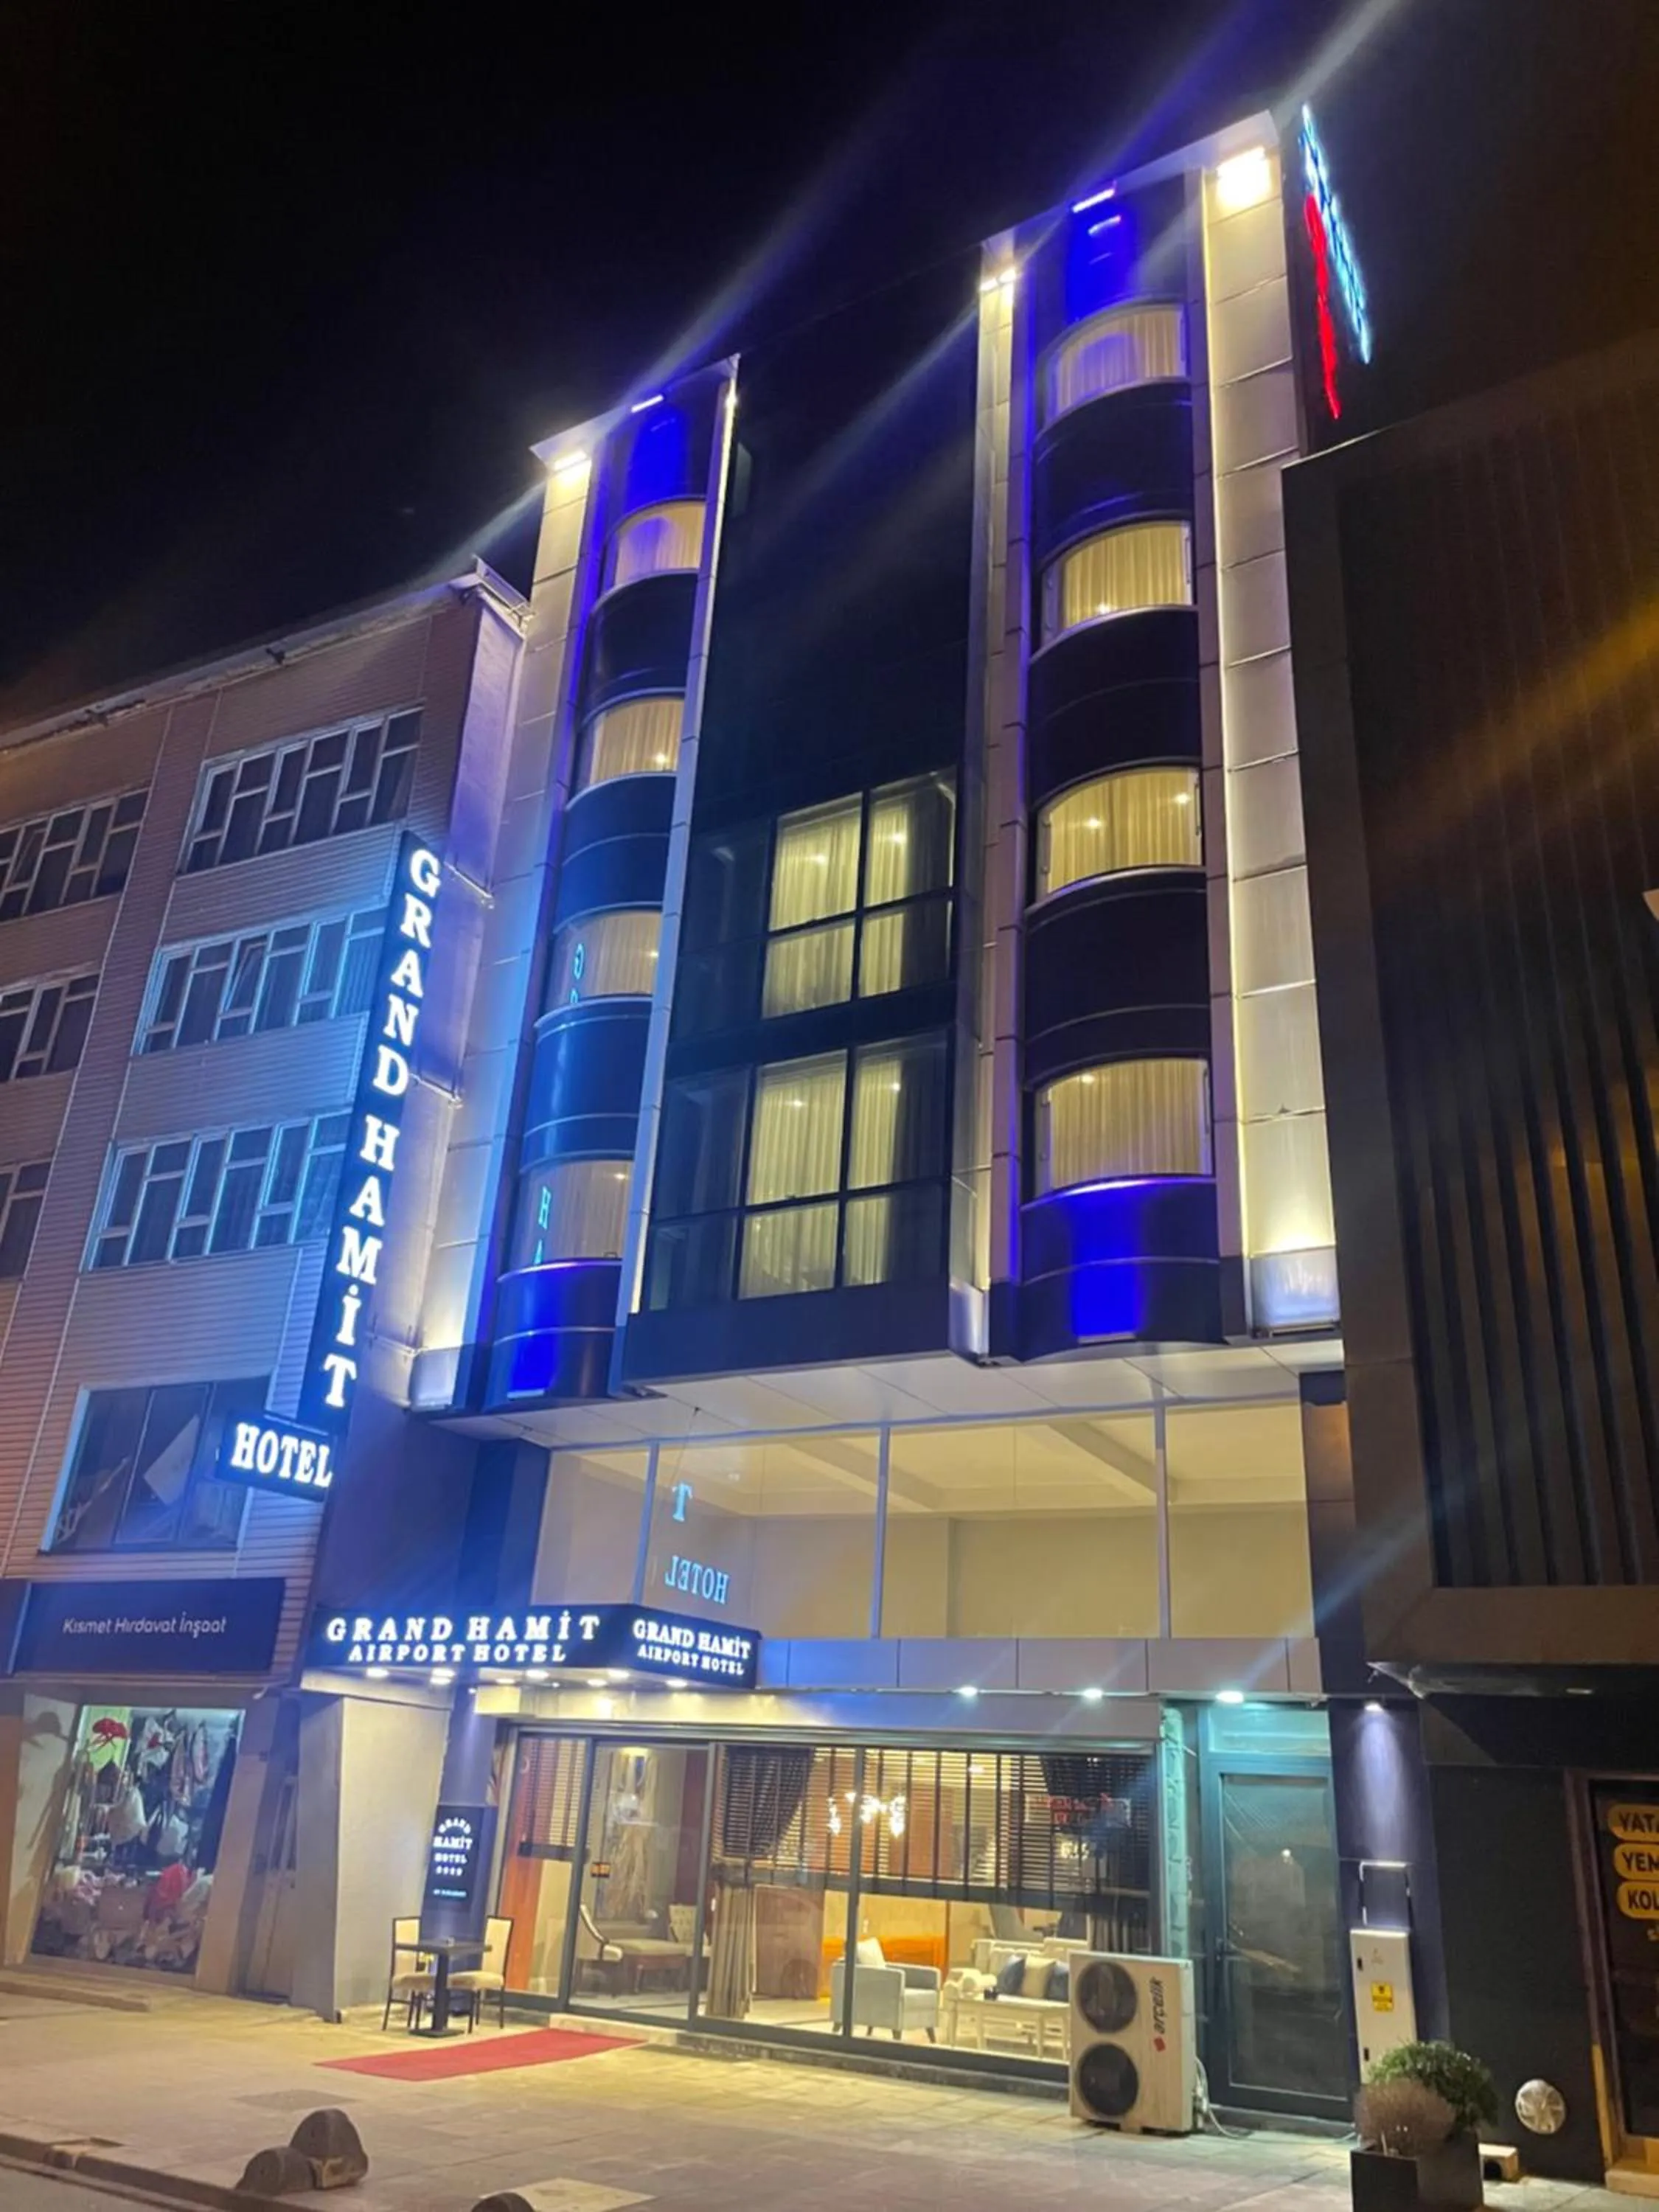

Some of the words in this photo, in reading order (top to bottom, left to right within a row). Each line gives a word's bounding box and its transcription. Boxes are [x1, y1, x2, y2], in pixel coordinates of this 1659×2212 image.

[372, 848, 441, 1097] GRAND
[323, 1114, 400, 1408] HAMİT
[230, 1422, 333, 1488] HOTEL
[326, 1616, 453, 1642] GRAND
[466, 1610, 600, 1641] HAMİT
[633, 1618, 695, 1649] GRAND
[698, 1632, 751, 1660] HAMİT
[348, 1644, 466, 1663] AIRPORT
[473, 1644, 566, 1663] HOTEL
[637, 1644, 700, 1667] AIRPORT
[701, 1655, 745, 1676] HOTEL
